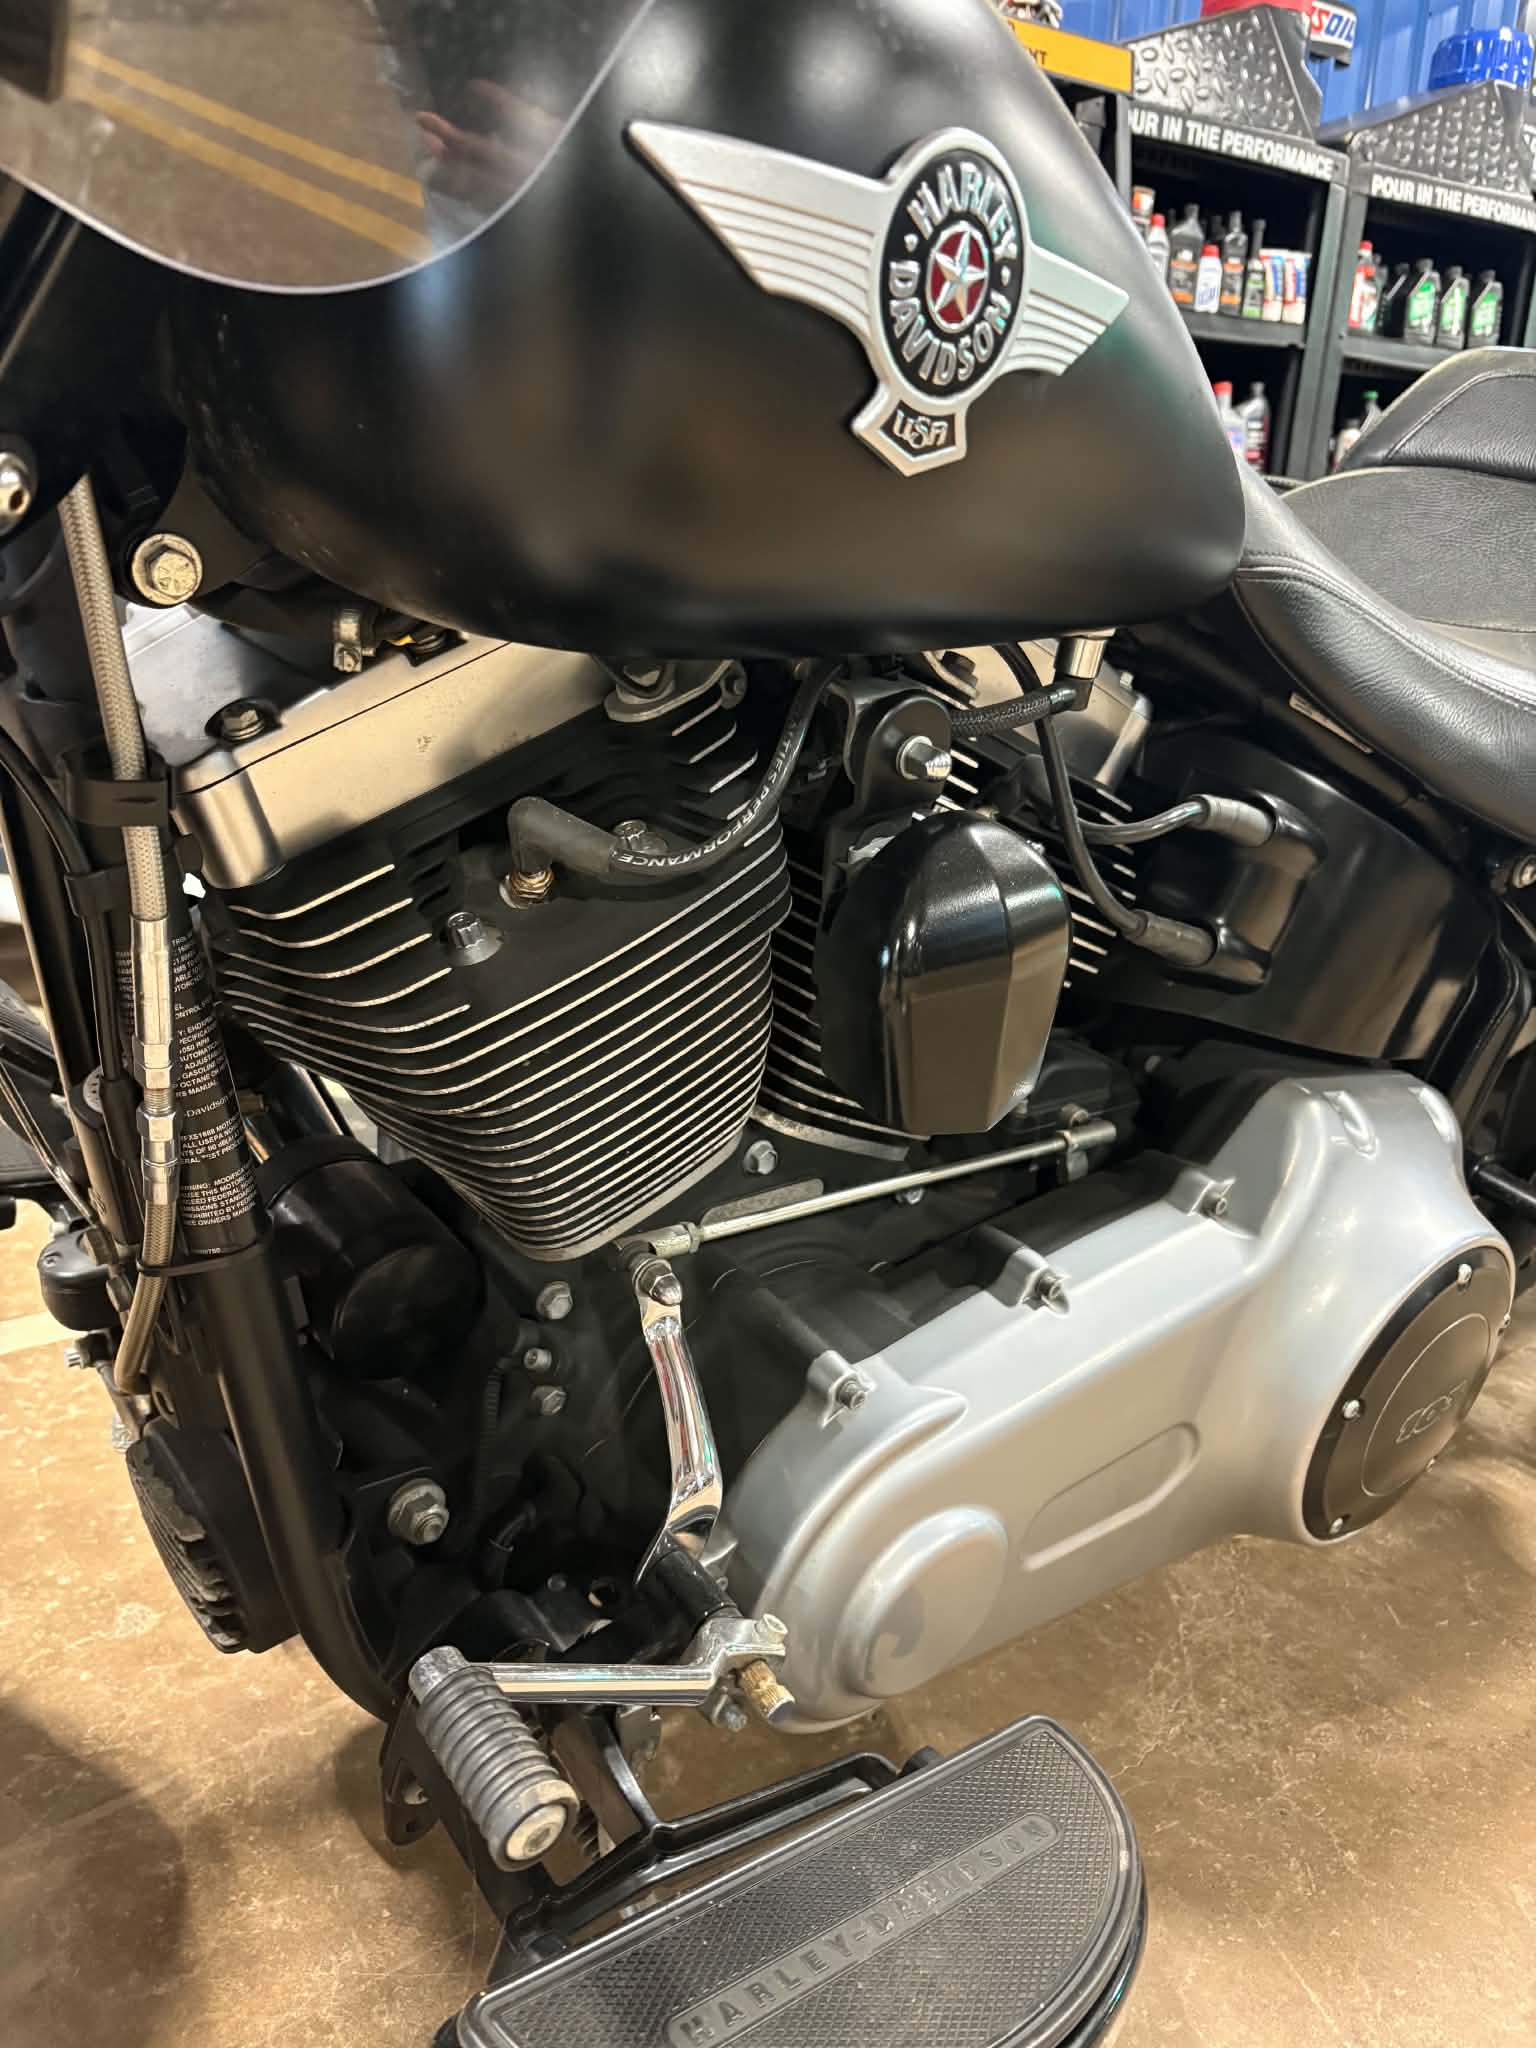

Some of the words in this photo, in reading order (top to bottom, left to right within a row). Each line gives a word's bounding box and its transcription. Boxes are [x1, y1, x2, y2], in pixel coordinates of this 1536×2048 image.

[1309, 6, 1354, 42] SOIL
[1128, 108, 1159, 136] UR
[1162, 115, 1183, 142] IN
[1185, 119, 1221, 151] THE
[1222, 129, 1335, 181] PERFORMANCE
[906, 161, 1018, 262] HARLEY
[1371, 173, 1416, 203] POUR
[1416, 183, 1434, 207] IN
[1434, 186, 1463, 213] THE
[889, 261, 1012, 386] DAVIDSON
[894, 409, 950, 449] USA
[617, 781, 771, 867] PERFORMANCE
[179, 1073, 211, 1089] OCTANE
[200, 1188, 219, 1197] THIS
[207, 1187, 239, 1203] FEDERAL
[197, 1213, 232, 1226] OWNERS
[678, 1817, 1052, 2043] HARLEY-DAVIDSON
